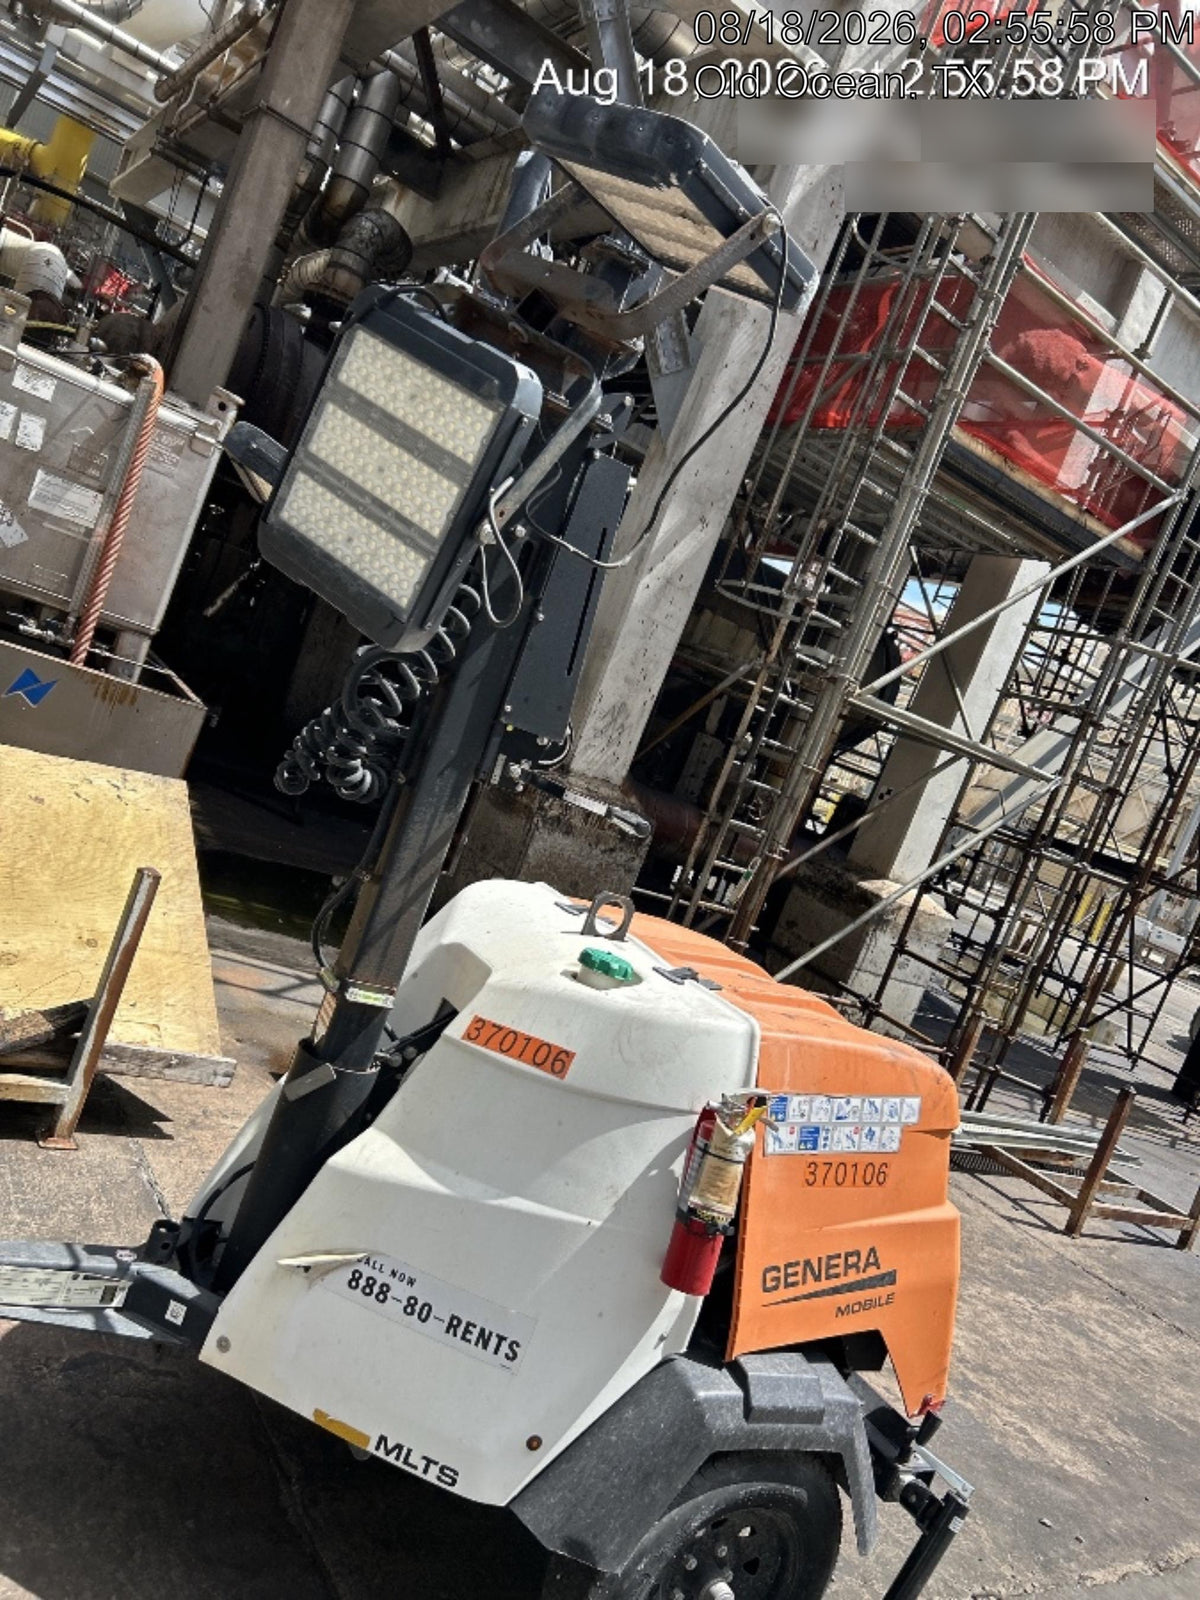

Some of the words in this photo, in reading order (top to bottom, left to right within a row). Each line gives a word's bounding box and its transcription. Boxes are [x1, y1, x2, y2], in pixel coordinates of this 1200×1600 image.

[467, 1018, 570, 1075] 370106
[805, 1161, 889, 1186] 370106
[388, 1268, 417, 1288] NOW
[347, 1268, 521, 1363] 888-80-RENTS
[834, 1291, 896, 1318] MOBILE
[374, 1434, 460, 1487] MLTS
